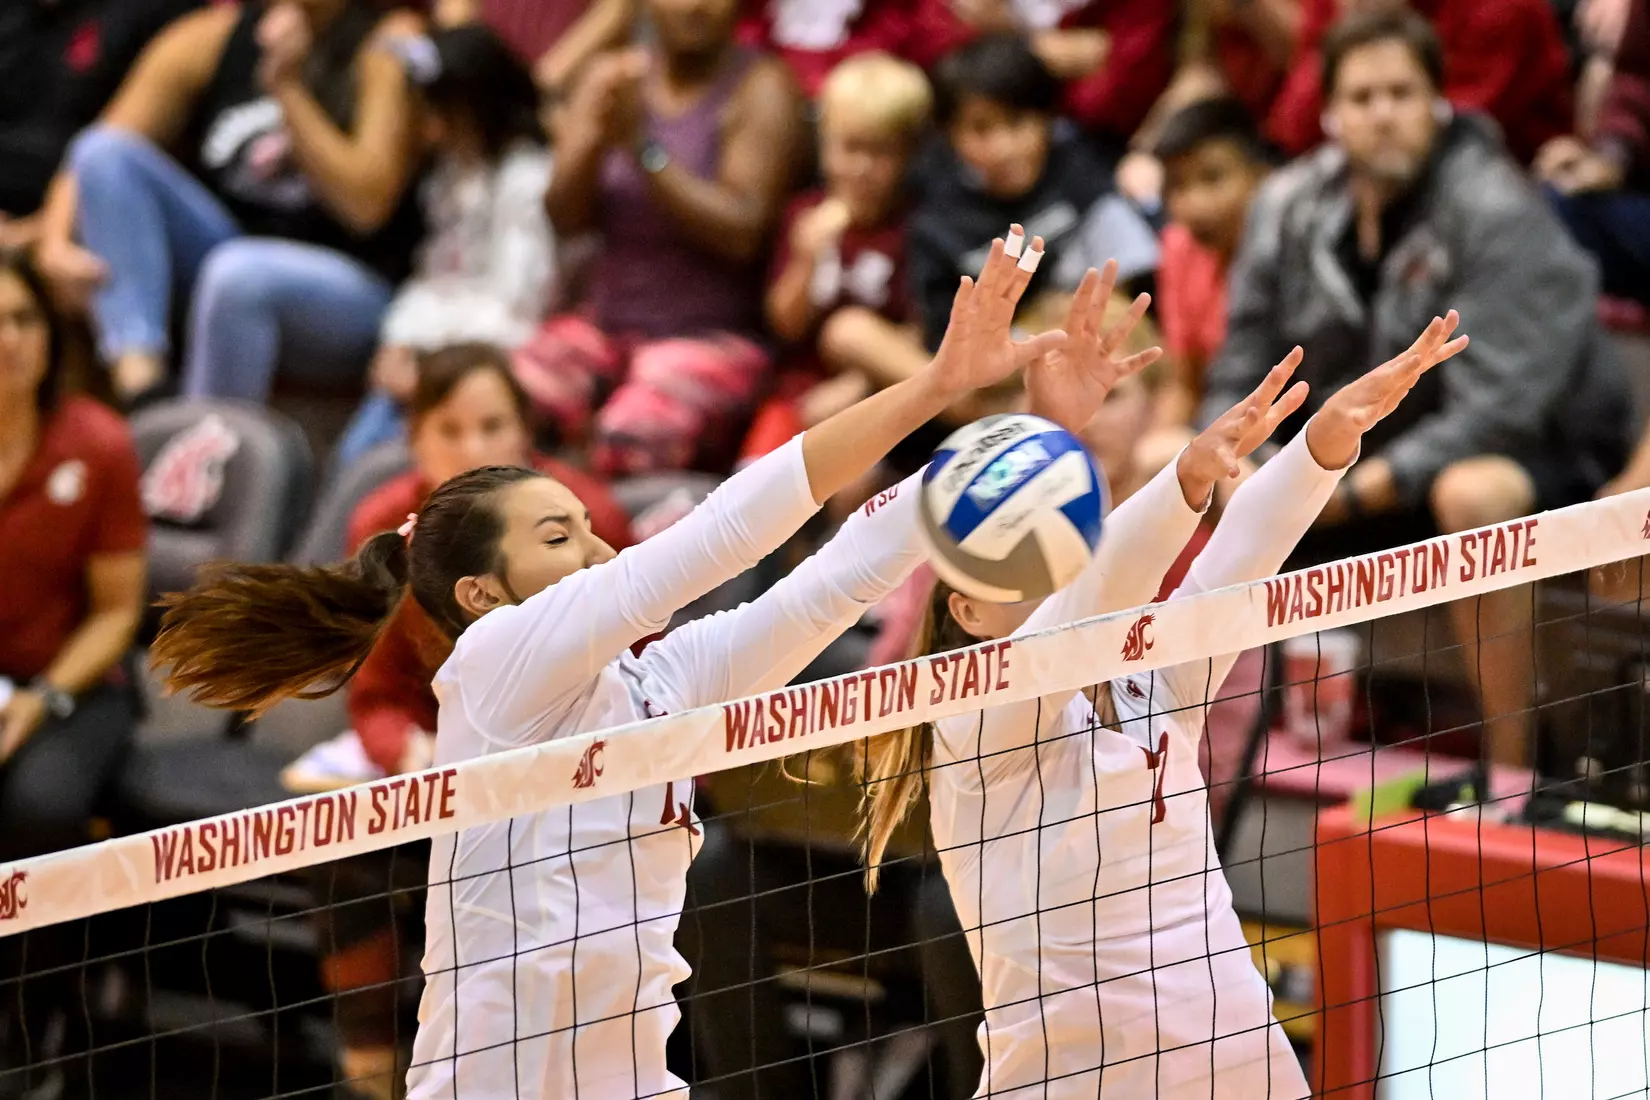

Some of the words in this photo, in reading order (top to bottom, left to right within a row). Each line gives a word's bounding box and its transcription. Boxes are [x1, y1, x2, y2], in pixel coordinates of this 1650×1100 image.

[1265, 540, 1449, 627] WASHINGTON
[1460, 519, 1538, 582] STATE
[724, 661, 918, 752] WASHINGTON
[930, 640, 1012, 705] STATE
[151, 791, 357, 883] WASHINGTON
[368, 768, 457, 834] STATE
